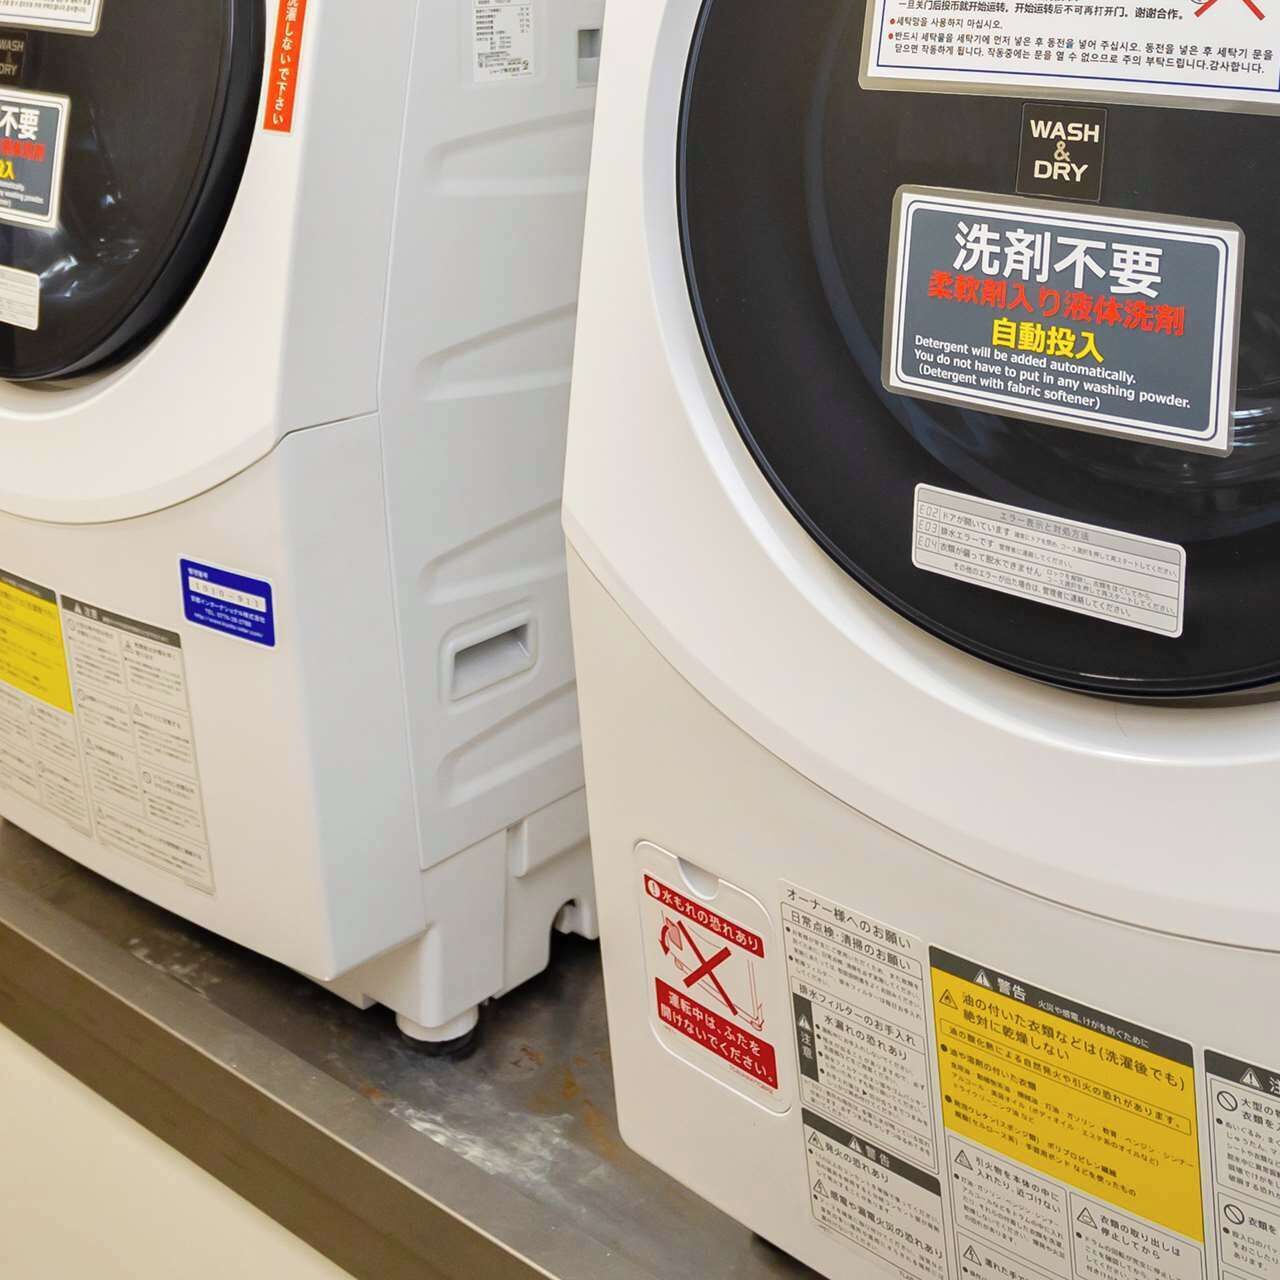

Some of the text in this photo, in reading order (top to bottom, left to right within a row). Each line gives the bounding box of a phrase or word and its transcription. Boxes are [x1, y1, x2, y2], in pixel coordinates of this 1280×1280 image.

[931, 18, 964, 28] 사용하지
[1030, 119, 1100, 143] WASH
[1054, 140, 1070, 162] &
[1033, 160, 1089, 182] DRY
[952, 221, 1162, 299] 洗剤不要
[928, 268, 1187, 337] 柔軟剤入り液体洗剤
[915, 335, 1136, 385] Detergent will be added automatically.
[992, 317, 1105, 364] 自動投入
[914, 349, 1191, 409] You do not have to put in any washing powder.
[919, 363, 1101, 410] (Detergent with fabric softener)
[662, 887, 759, 952] 水もれの恐れあり
[786, 886, 912, 950] オーナー様へのお願い
[799, 983, 916, 1047] 排水フィルターのお手入れ
[997, 977, 1026, 1002] 警告
[660, 1002, 774, 1082] 開けないでください。
[668, 990, 761, 1057] 運転中は、ふたを
[824, 1014, 908, 1062] 水漏れの恐れあり
[963, 1008, 1070, 1060] 絶対に乾燥しない
